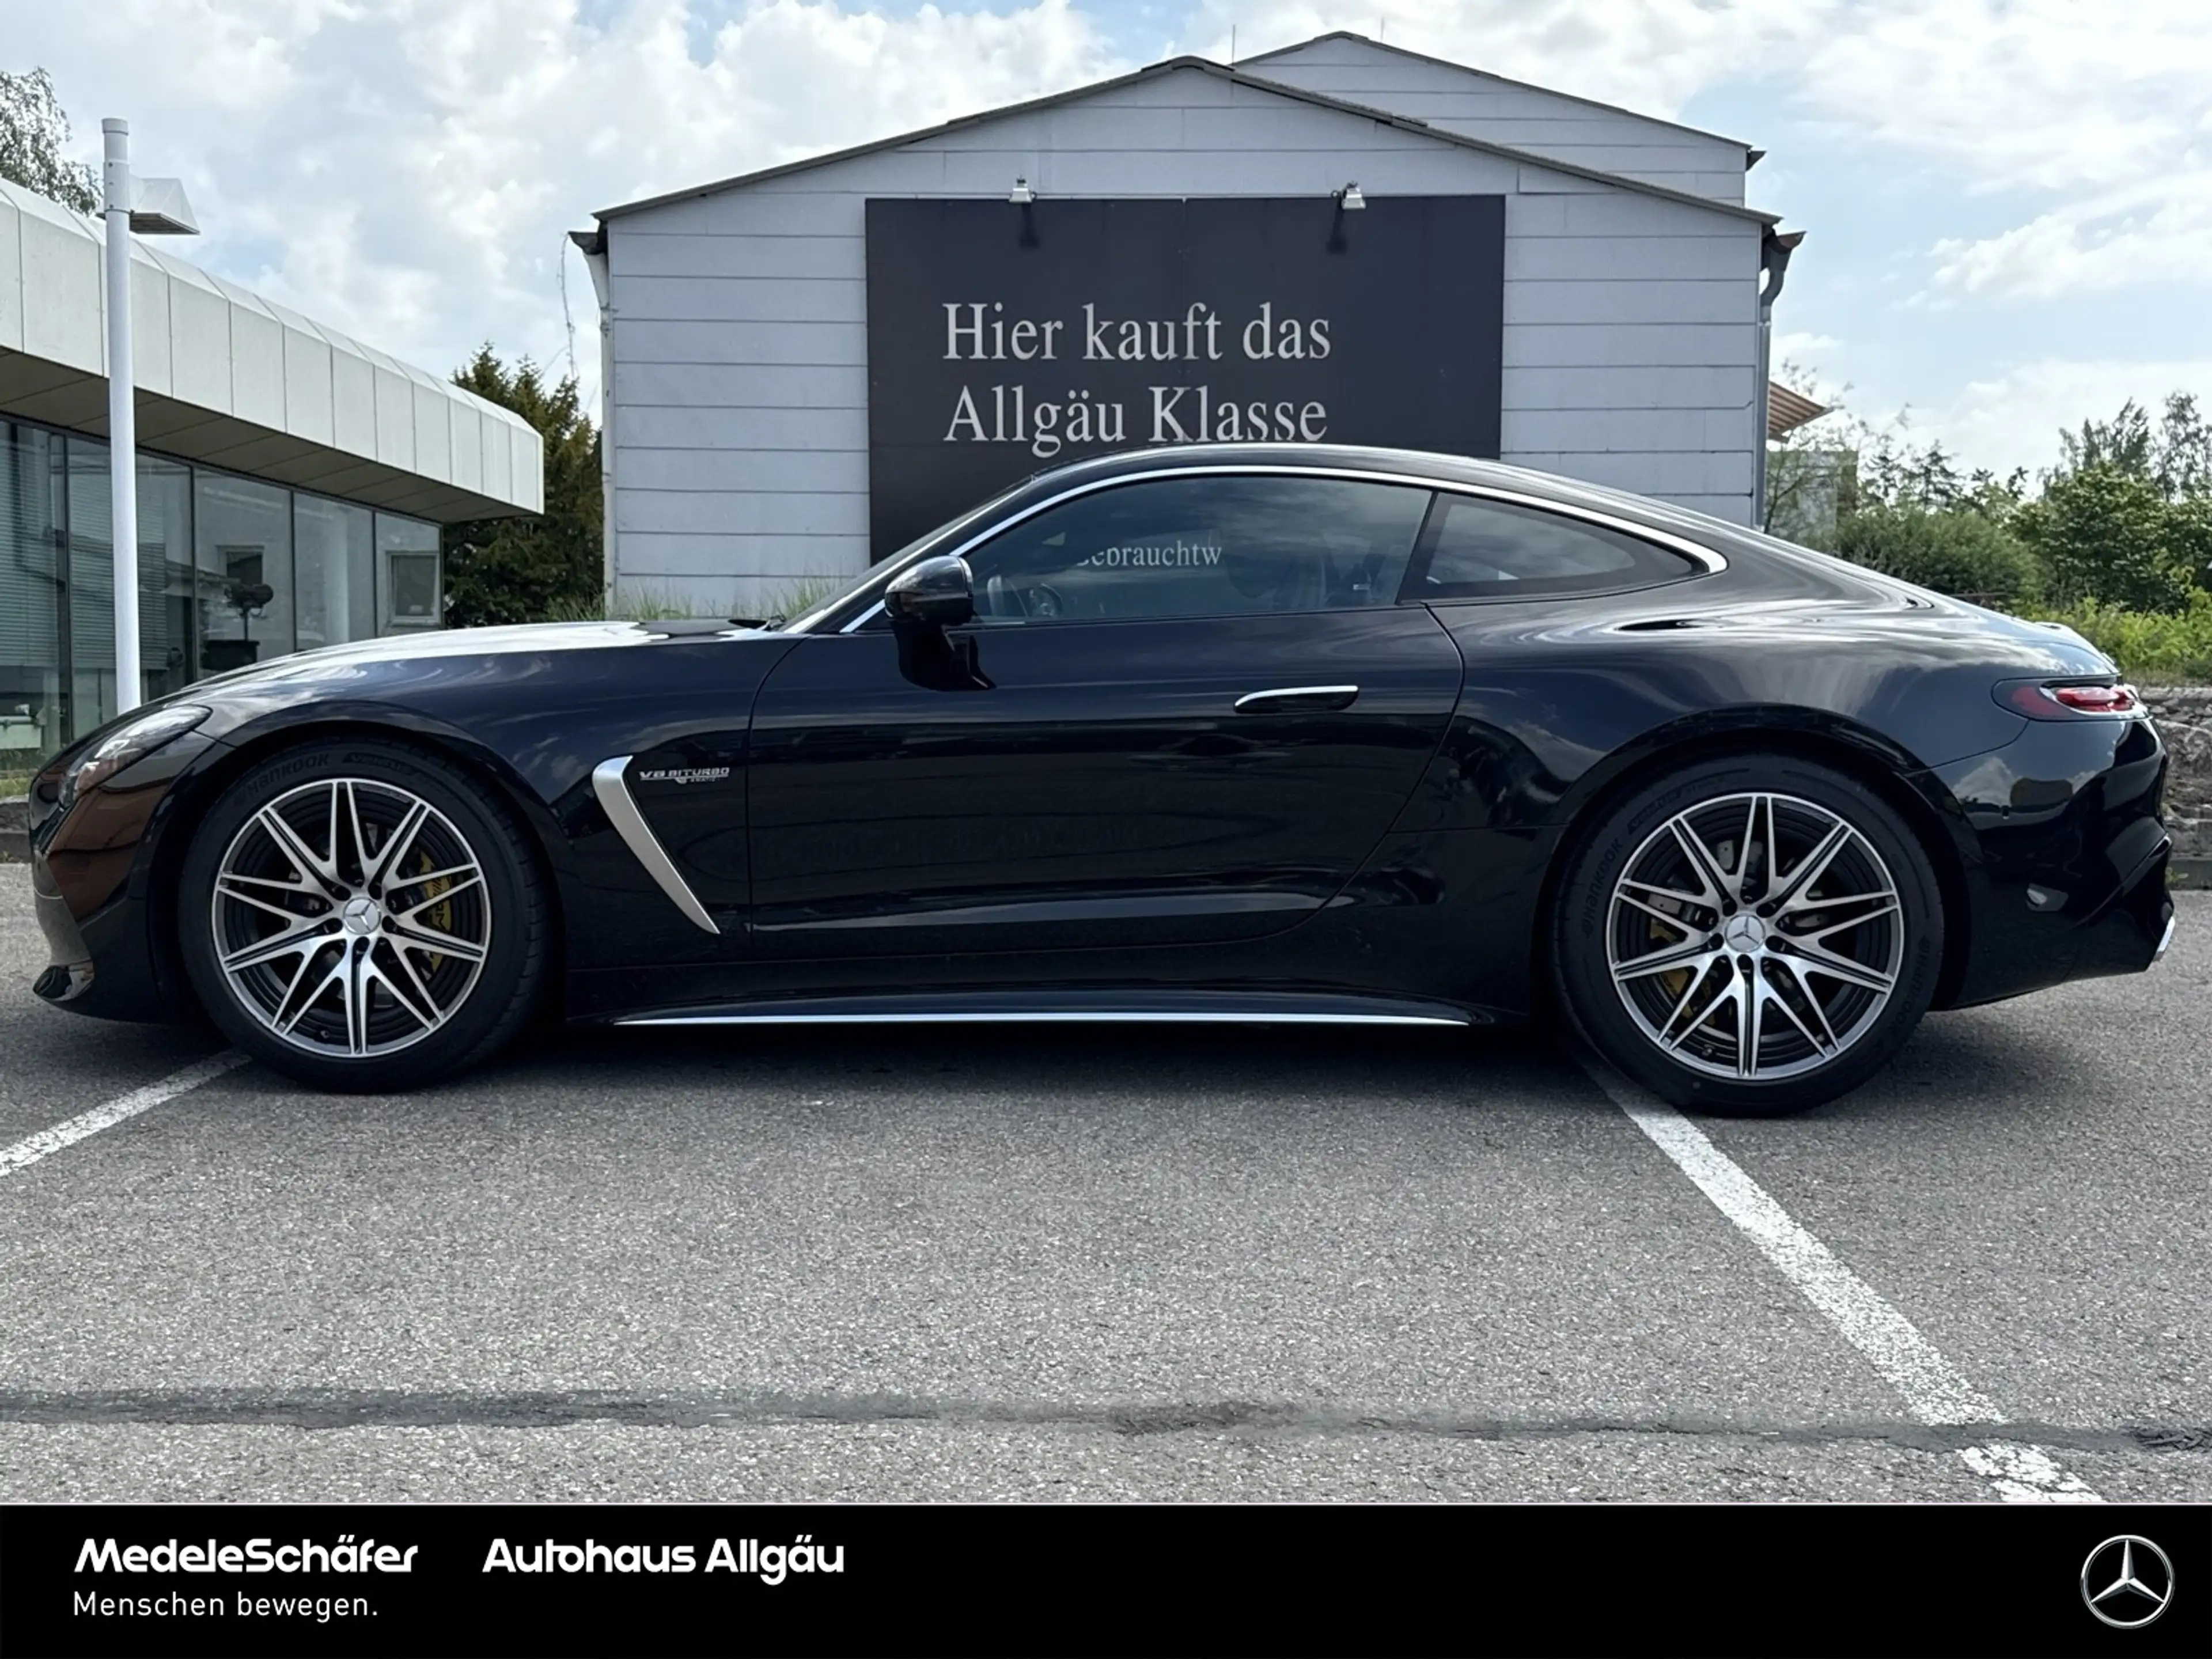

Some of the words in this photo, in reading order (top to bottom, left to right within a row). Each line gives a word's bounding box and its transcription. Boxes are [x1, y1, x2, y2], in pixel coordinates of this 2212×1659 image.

[942, 302, 1063, 359] Hier
[1082, 302, 1223, 360] kauft
[1243, 302, 1331, 359] das
[943, 385, 1126, 458] Allgäu
[1148, 385, 1327, 442] Klasse
[1077, 539, 1222, 566] ebrauchtw
[668, 767, 730, 778] BITURBO
